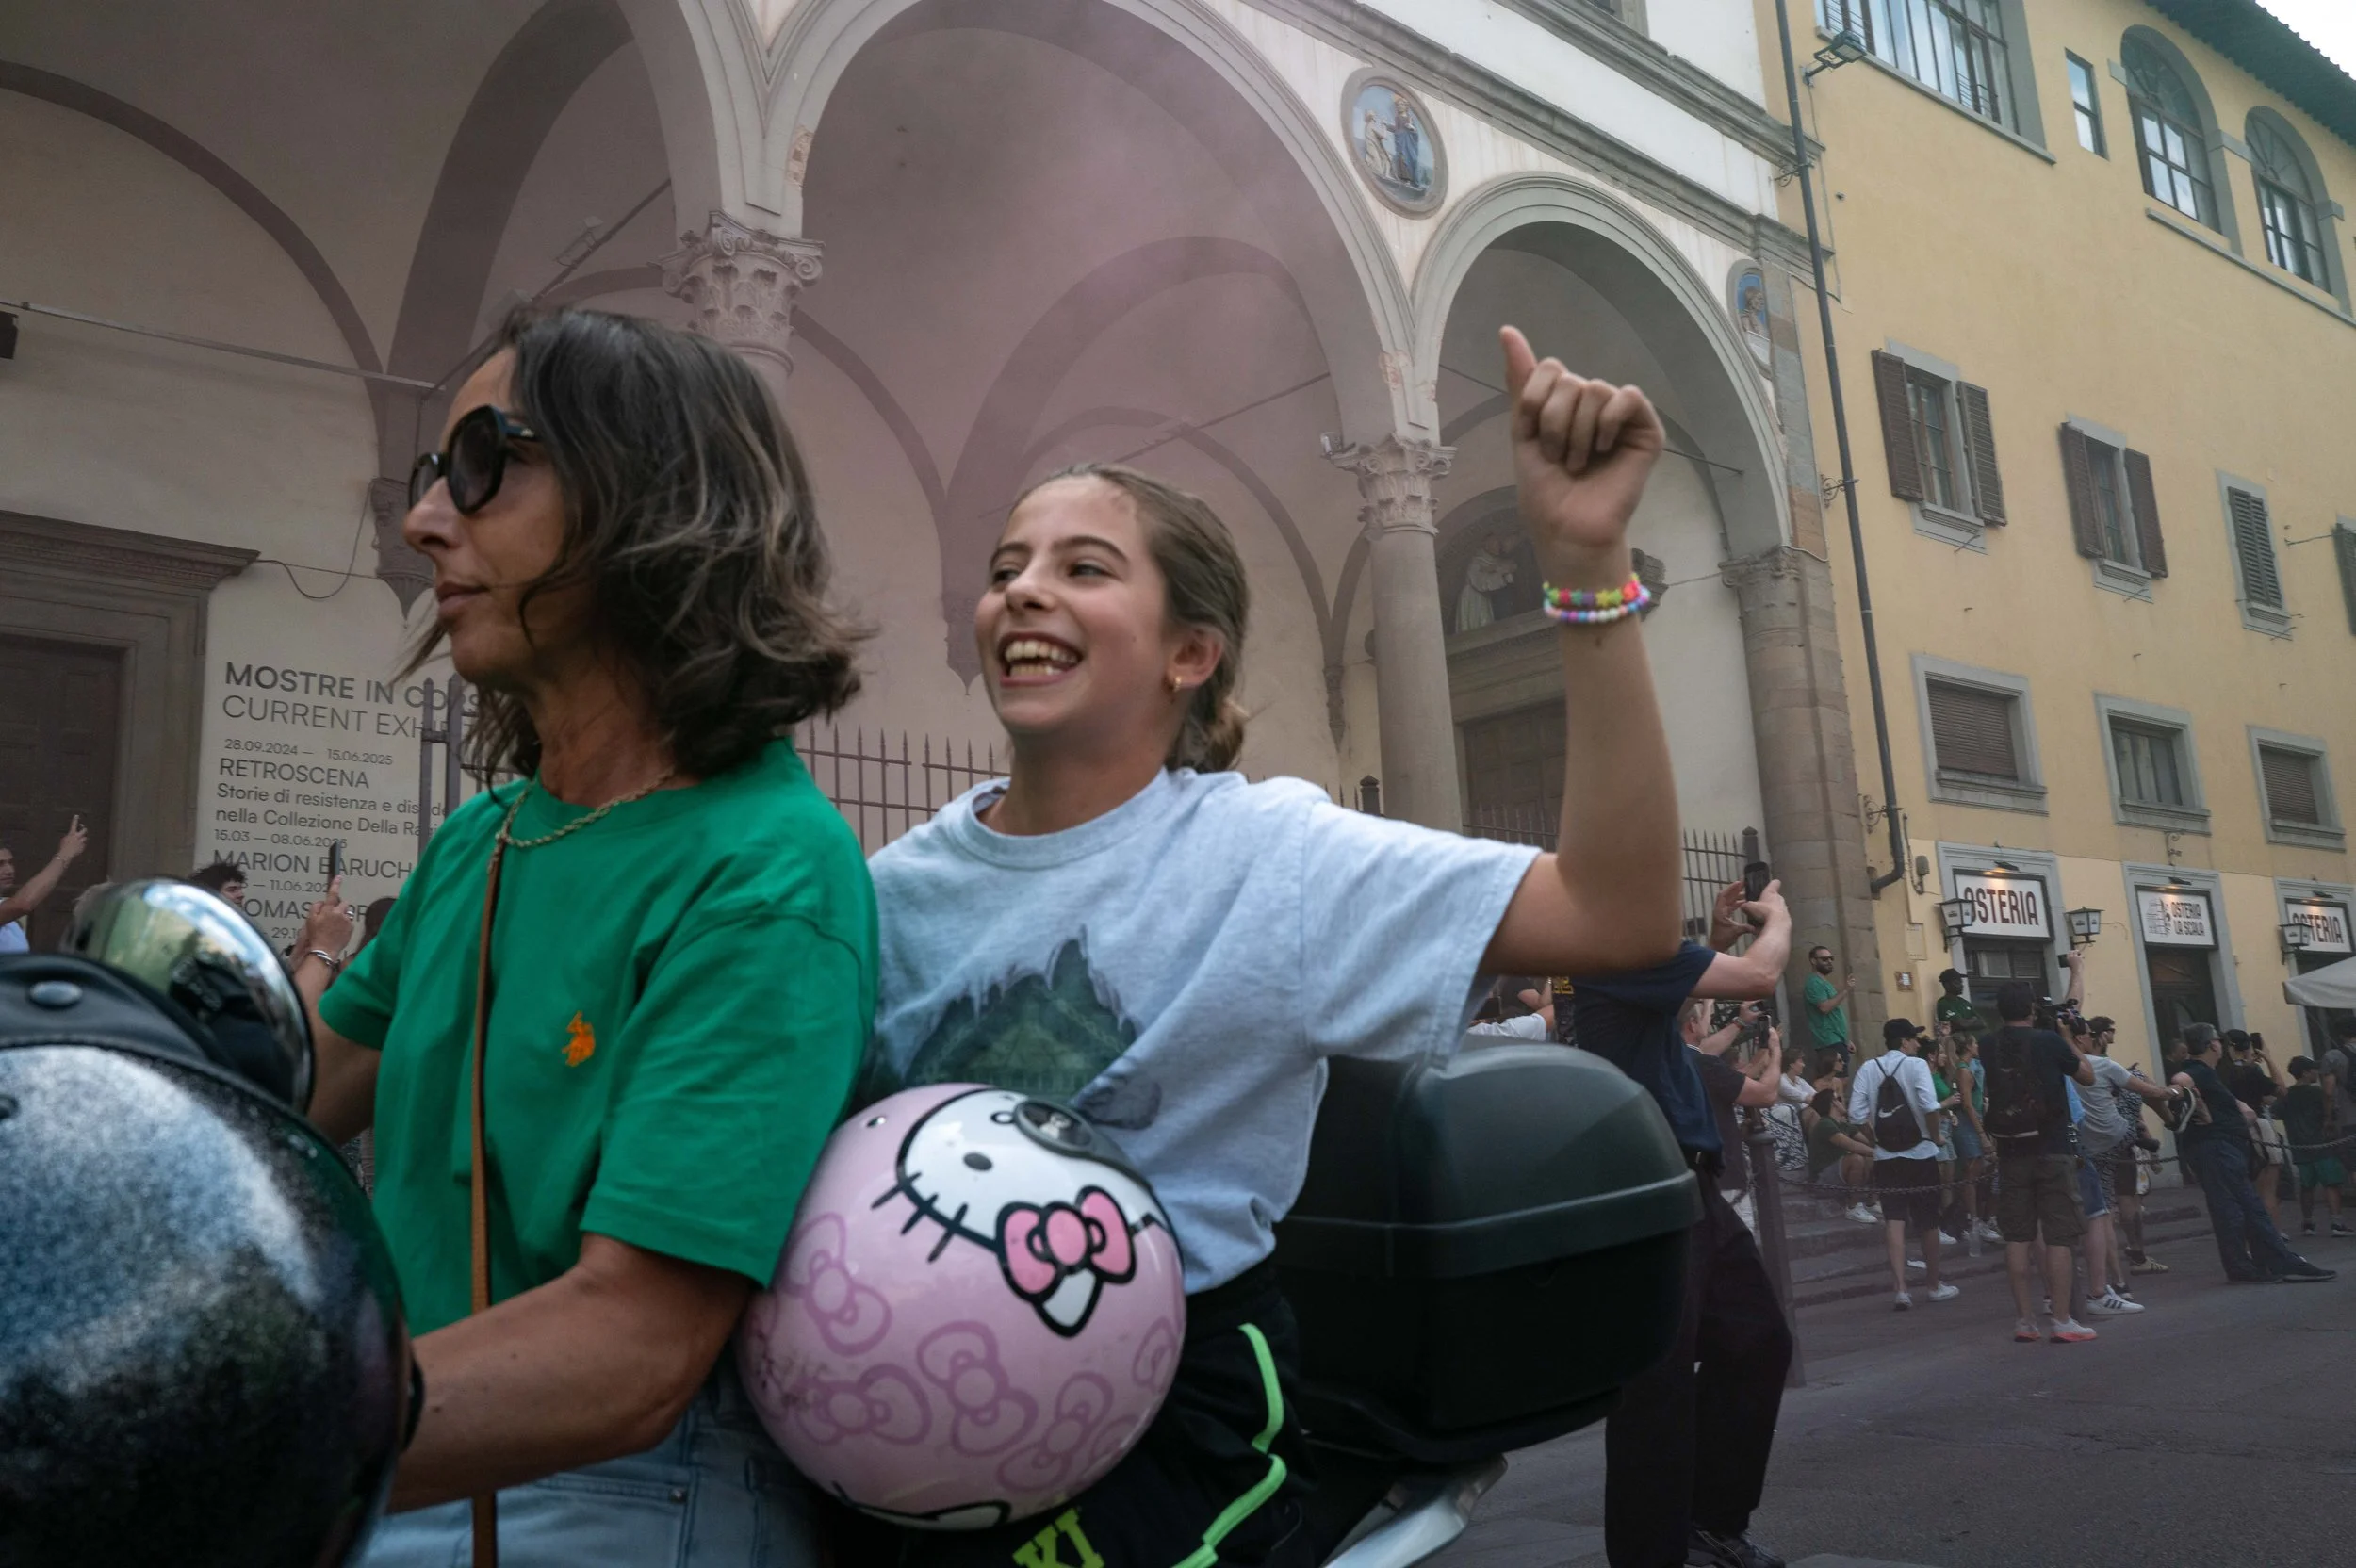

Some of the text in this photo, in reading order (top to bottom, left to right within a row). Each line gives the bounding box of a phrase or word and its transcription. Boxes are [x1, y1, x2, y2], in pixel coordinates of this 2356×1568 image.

[225, 662, 355, 699] MOSTRE
[366, 679, 394, 705] IN
[222, 695, 368, 732] CURRENT
[224, 738, 298, 756] 28.09.2024
[327, 748, 394, 766] 15.06.2025
[219, 757, 369, 789] RETROSCENA
[217, 782, 270, 801] Storie
[273, 789, 290, 803] di
[295, 792, 378, 810] resistenza
[382, 801, 393, 812] e
[214, 828, 251, 842] 15.03
[215, 807, 258, 824] nella
[263, 809, 352, 831] Collezione
[357, 817, 398, 834] Della
[213, 849, 310, 874] MARION
[270, 879, 330, 893] 11.06.202
[1963, 886, 2039, 925] OSTERIA
